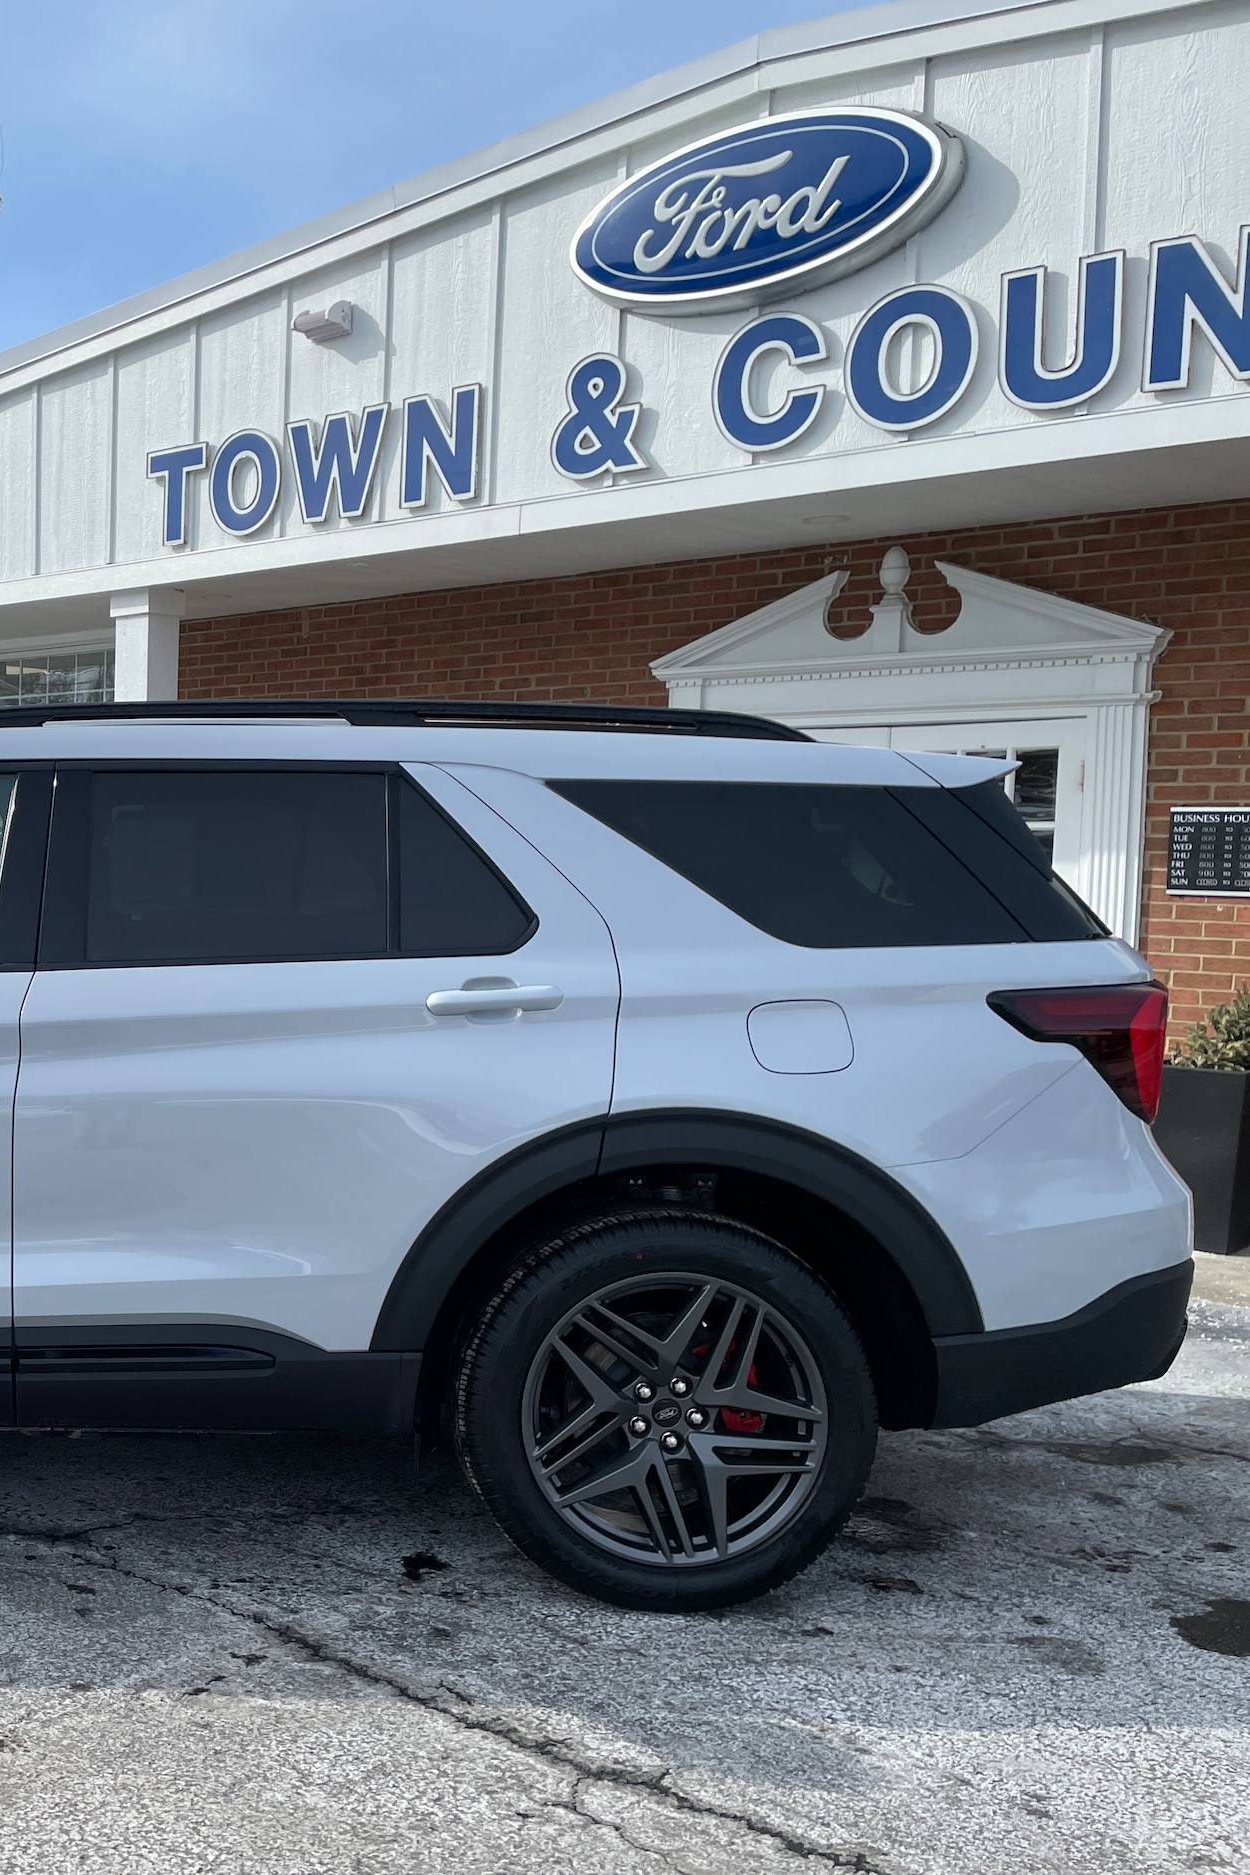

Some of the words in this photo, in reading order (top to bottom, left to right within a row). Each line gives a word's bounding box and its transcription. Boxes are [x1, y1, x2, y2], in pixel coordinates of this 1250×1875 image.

[633, 150, 851, 274] Ford
[146, 383, 482, 546] TOWN
[550, 352, 650, 480] &
[1173, 813, 1221, 823] BUSINESS
[1224, 813, 1250, 823] HOU
[1174, 834, 1189, 842] TUE
[1172, 843, 1193, 851] WED
[1173, 851, 1190, 859] THU
[1171, 860, 1184, 868] FRI
[1170, 869, 1186, 877] SAT
[1170, 878, 1189, 886] SUN
